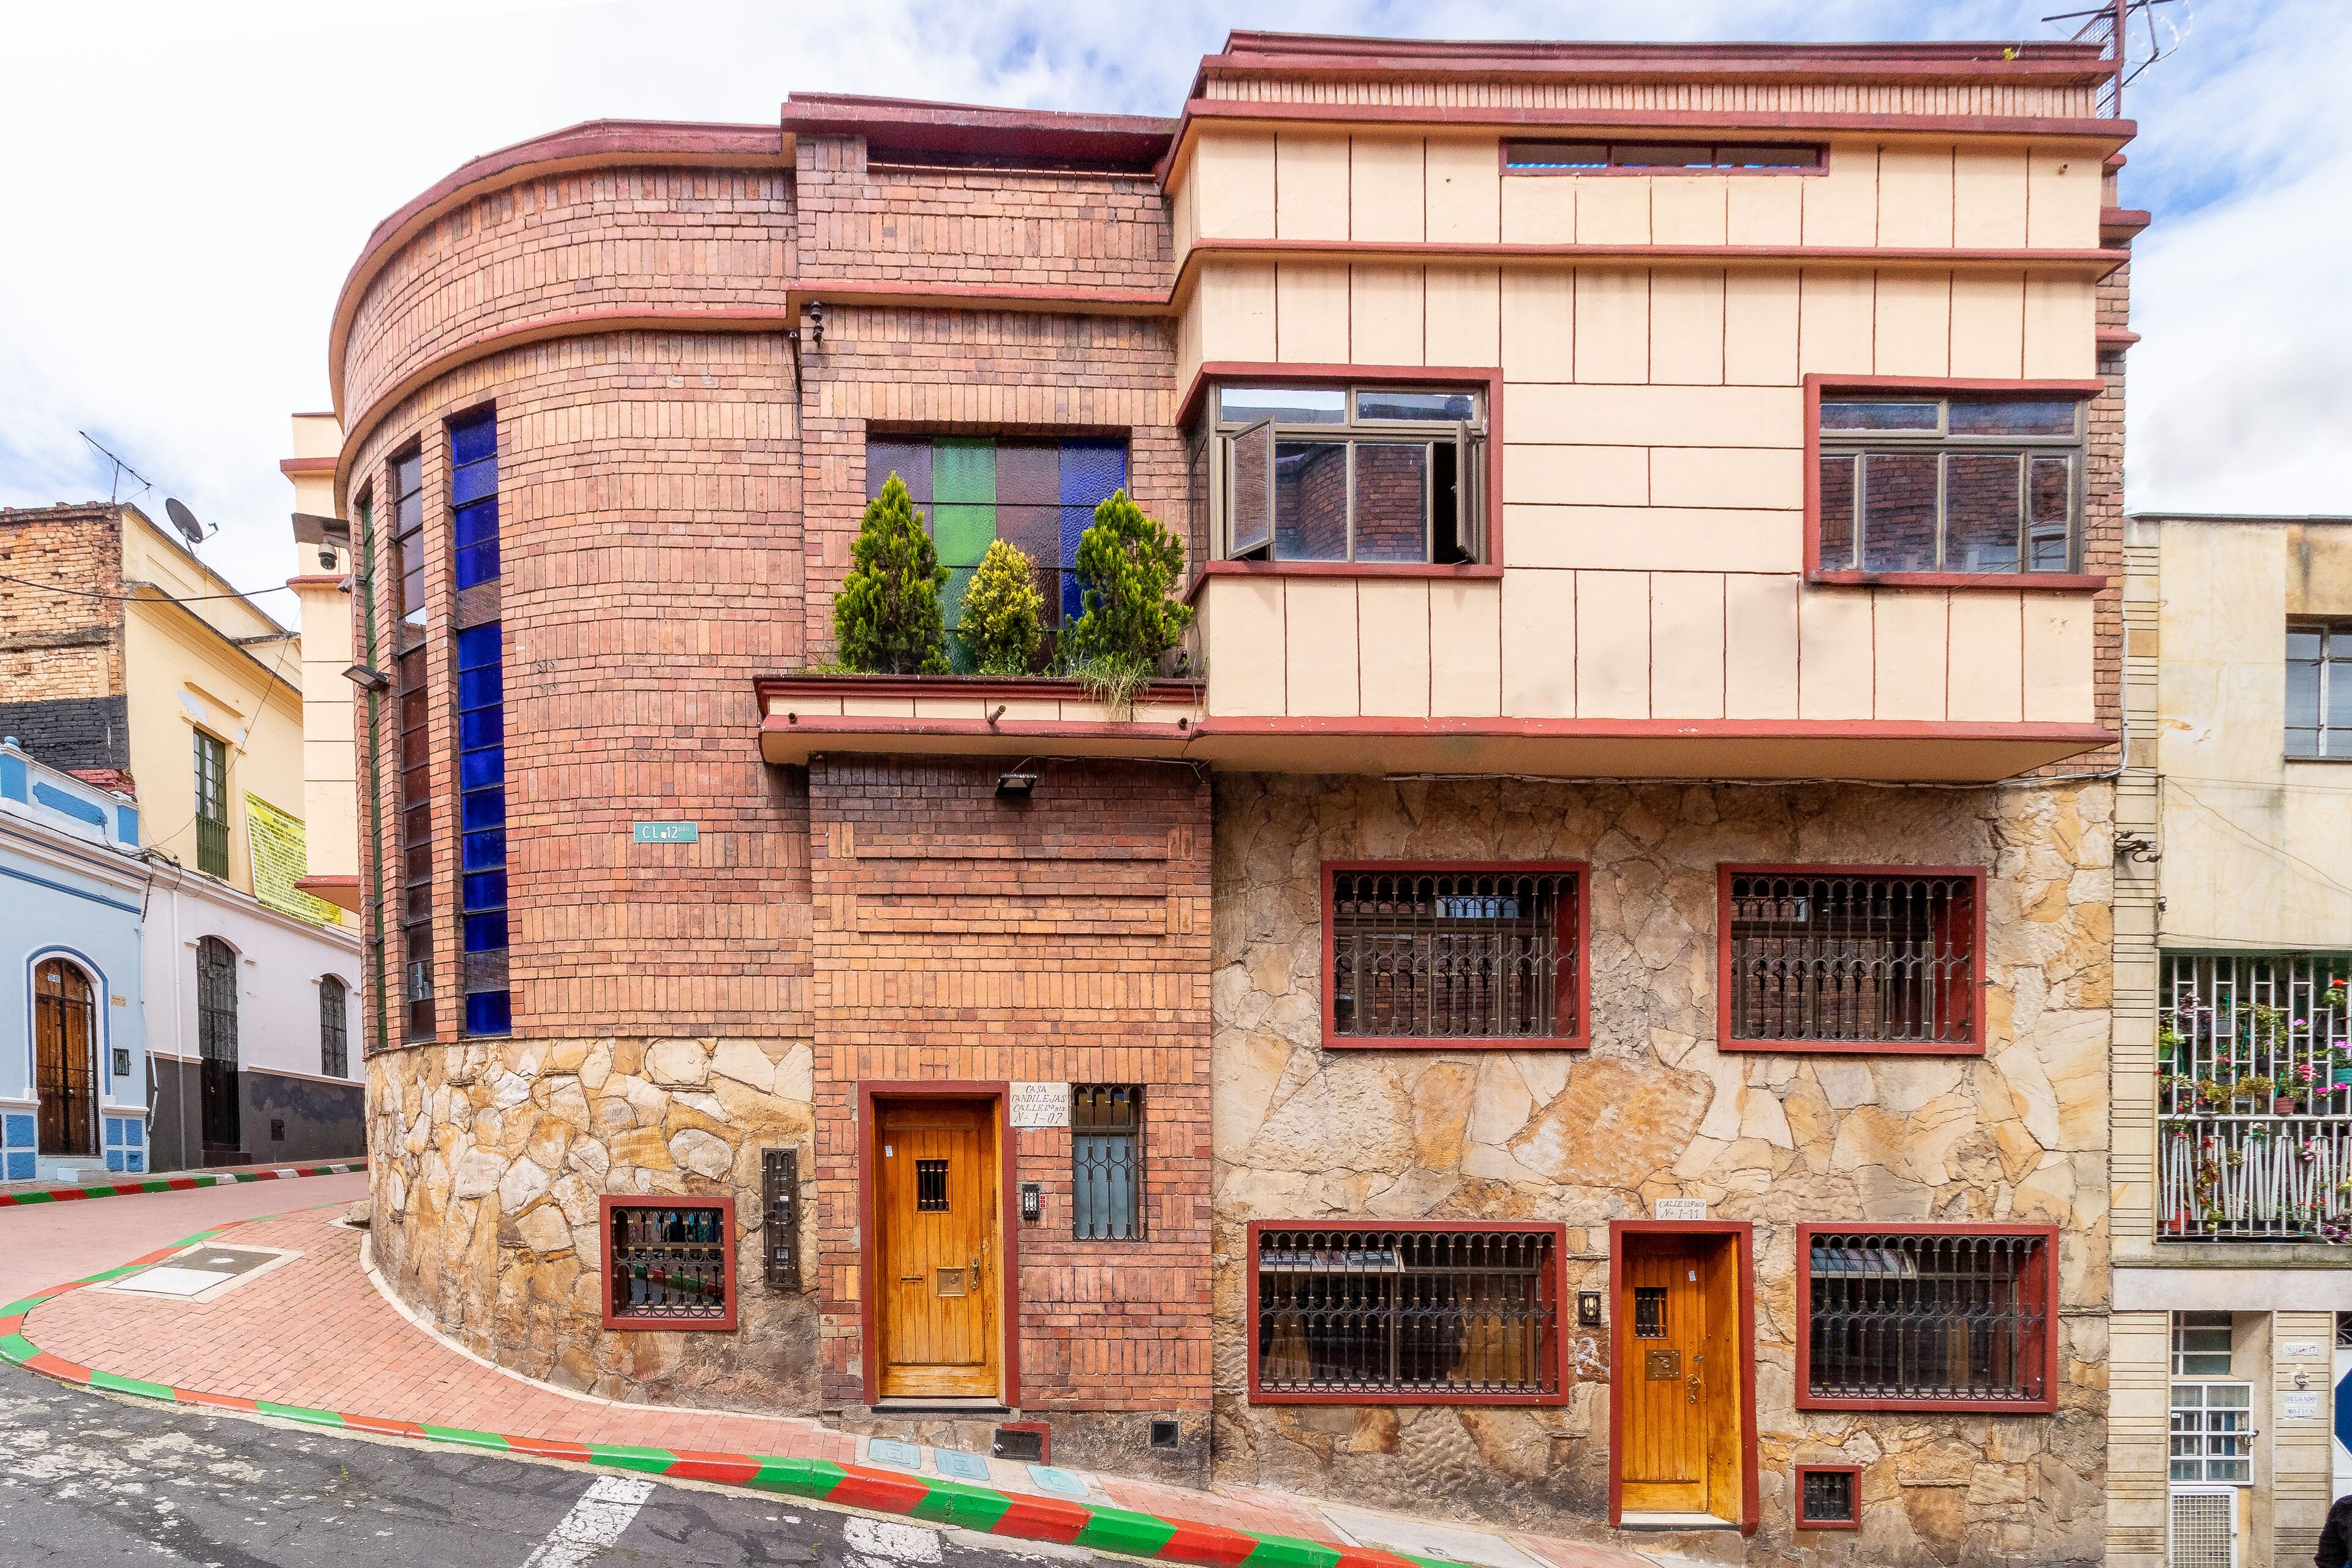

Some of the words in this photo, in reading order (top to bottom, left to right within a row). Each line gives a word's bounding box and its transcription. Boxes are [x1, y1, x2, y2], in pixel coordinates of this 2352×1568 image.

[1026, 1085, 1047, 1094] CASA
[1011, 1095, 1067, 1104] CANDILEJAS
[1013, 1104, 1043, 1112] CALLE
